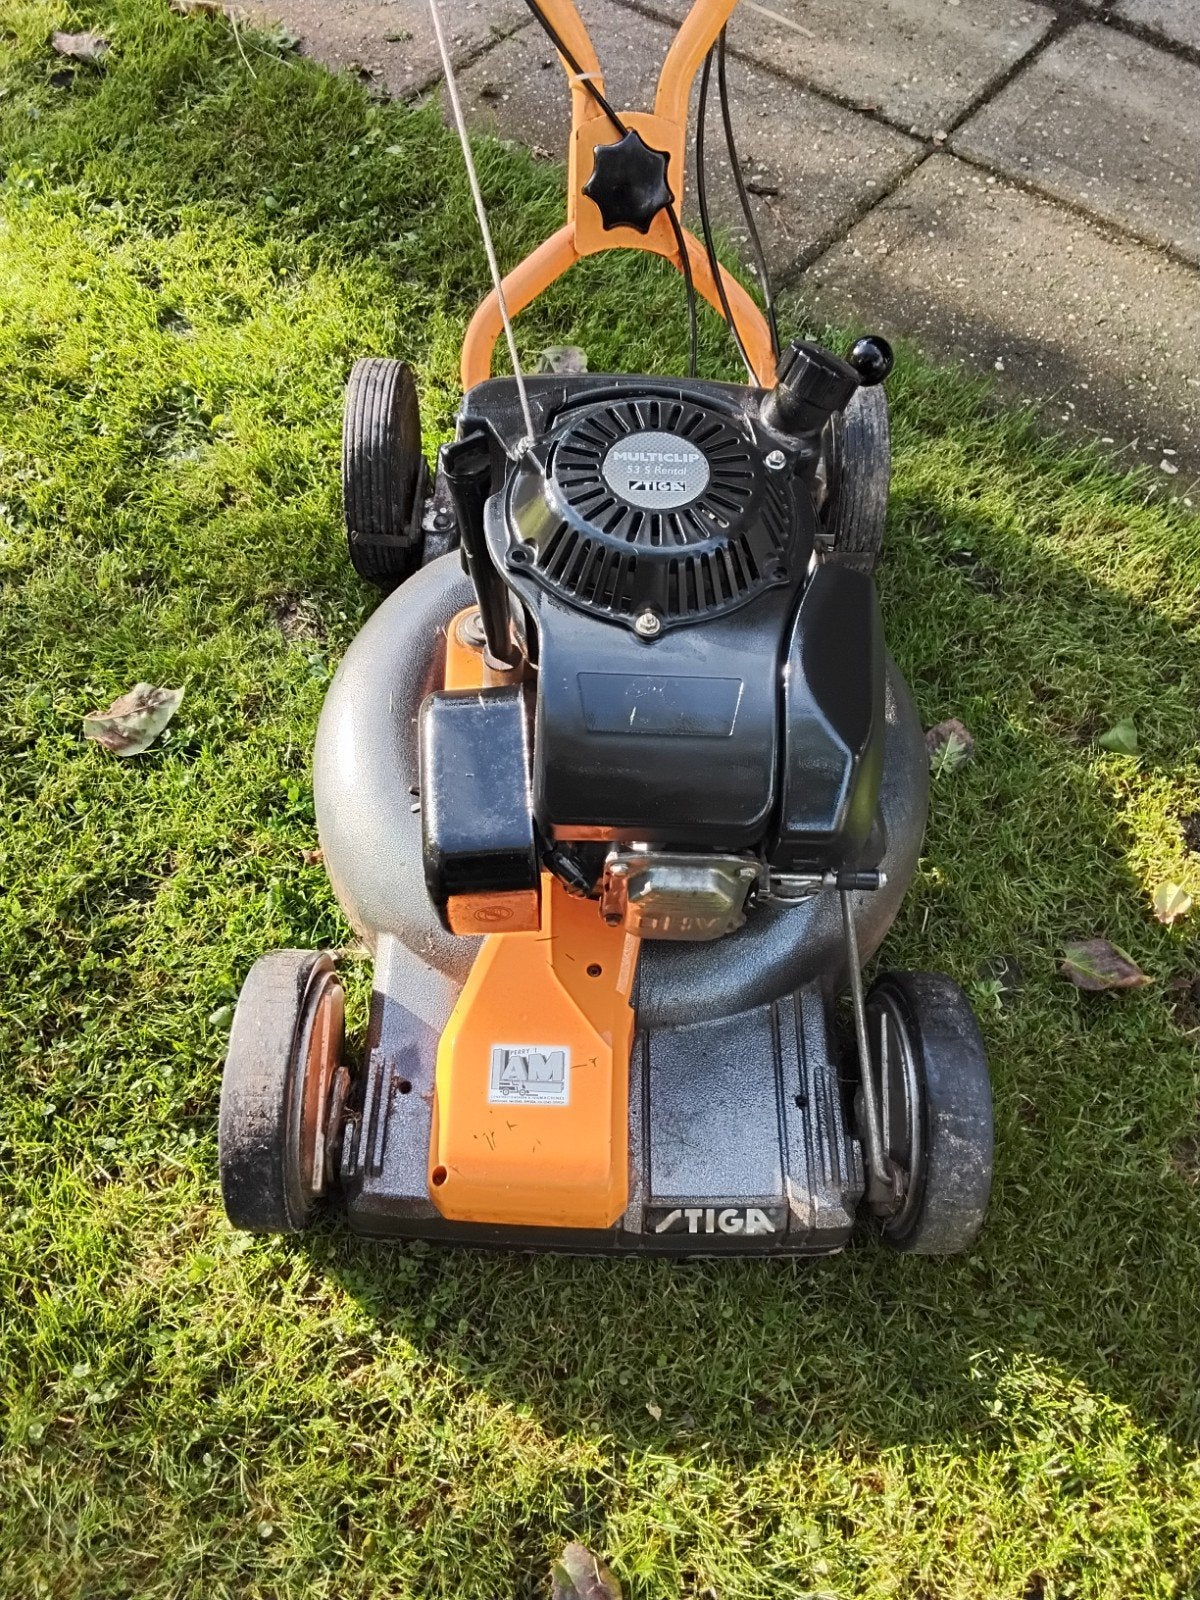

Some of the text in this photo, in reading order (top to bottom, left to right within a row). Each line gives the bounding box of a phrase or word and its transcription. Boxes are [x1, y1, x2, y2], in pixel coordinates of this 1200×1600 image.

[613, 451, 700, 463] MULTICLIP
[627, 465, 687, 476] 53 S Rental
[630, 481, 685, 491] STIGA
[655, 1208, 776, 1234] STIGA
